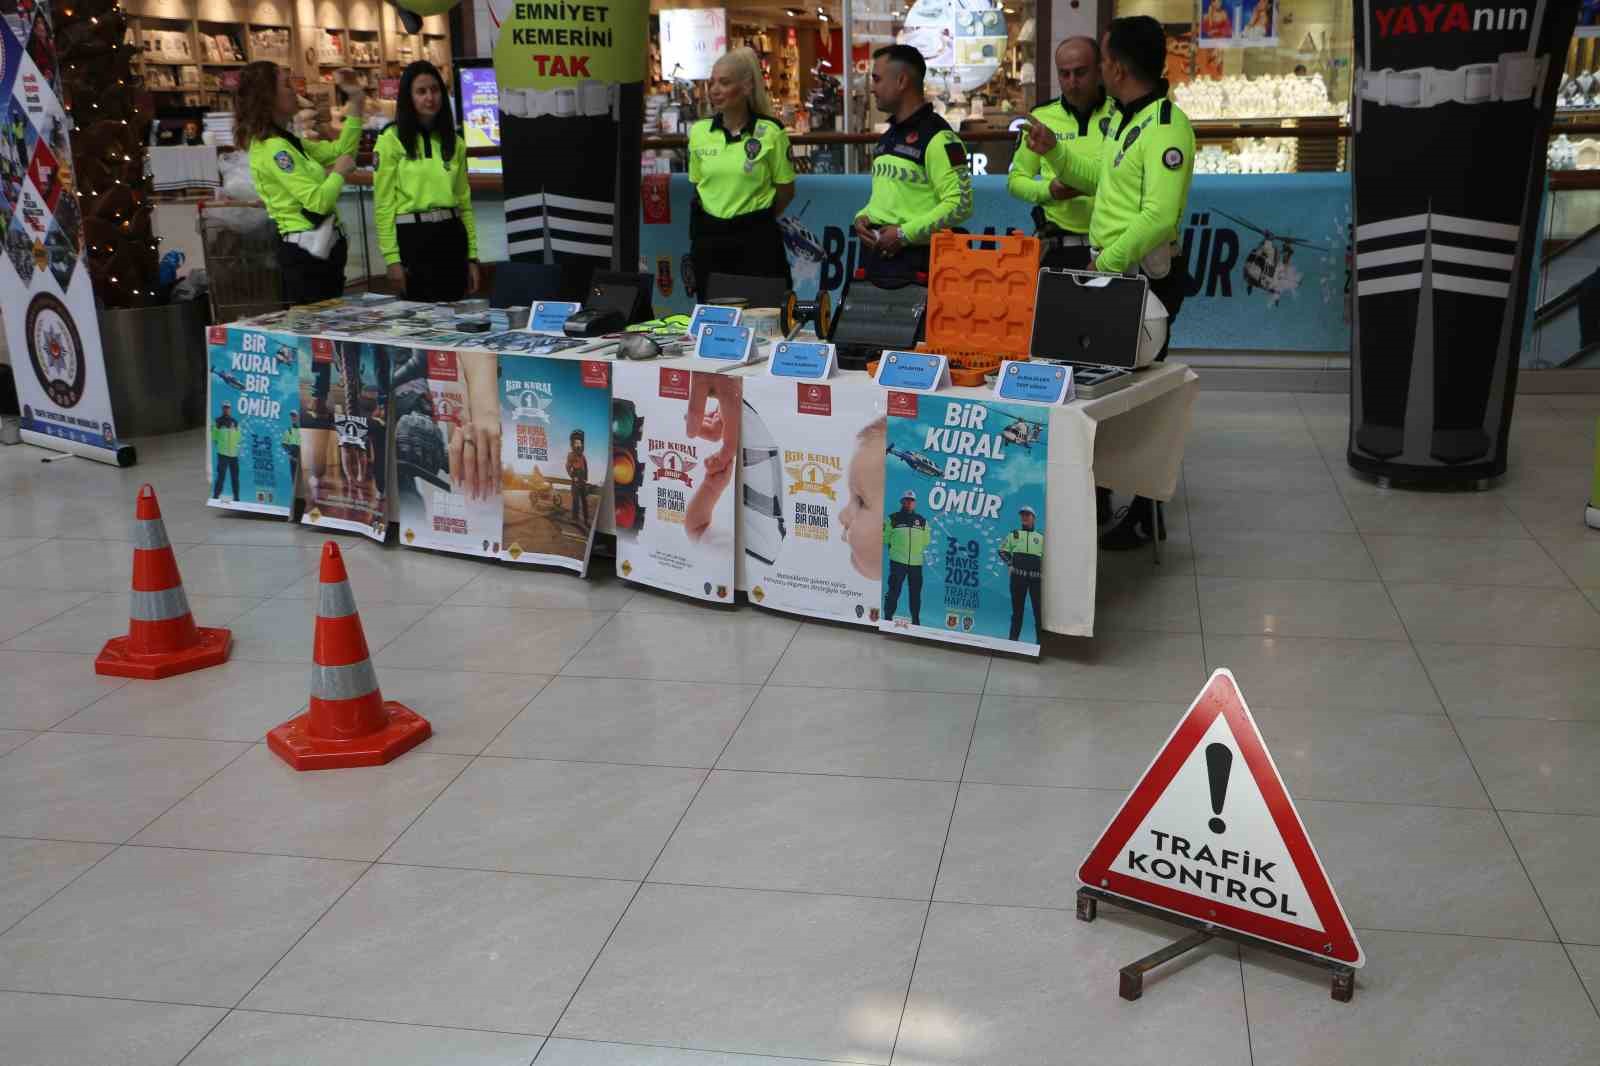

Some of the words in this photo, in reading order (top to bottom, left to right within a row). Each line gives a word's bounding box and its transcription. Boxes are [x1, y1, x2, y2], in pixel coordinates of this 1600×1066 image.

[515, 1, 608, 22] EMNİYET
[512, 27, 612, 47] KEMERİNİ
[533, 55, 591, 77] TAK
[231, 352, 279, 375] KURAL
[237, 392, 280, 419] ÖMÜR
[668, 442, 698, 460] KURAL
[924, 427, 1005, 460] KURAL
[668, 489, 685, 501] KURAL
[928, 481, 1002, 519] ÖMÜR
[808, 504, 828, 517] KURAL
[946, 536, 979, 559] 3-9
[945, 556, 979, 570] MAYIS
[945, 567, 979, 587] 2025
[1150, 829, 1277, 882] TRAFİK
[1128, 850, 1297, 917] KONTROL
